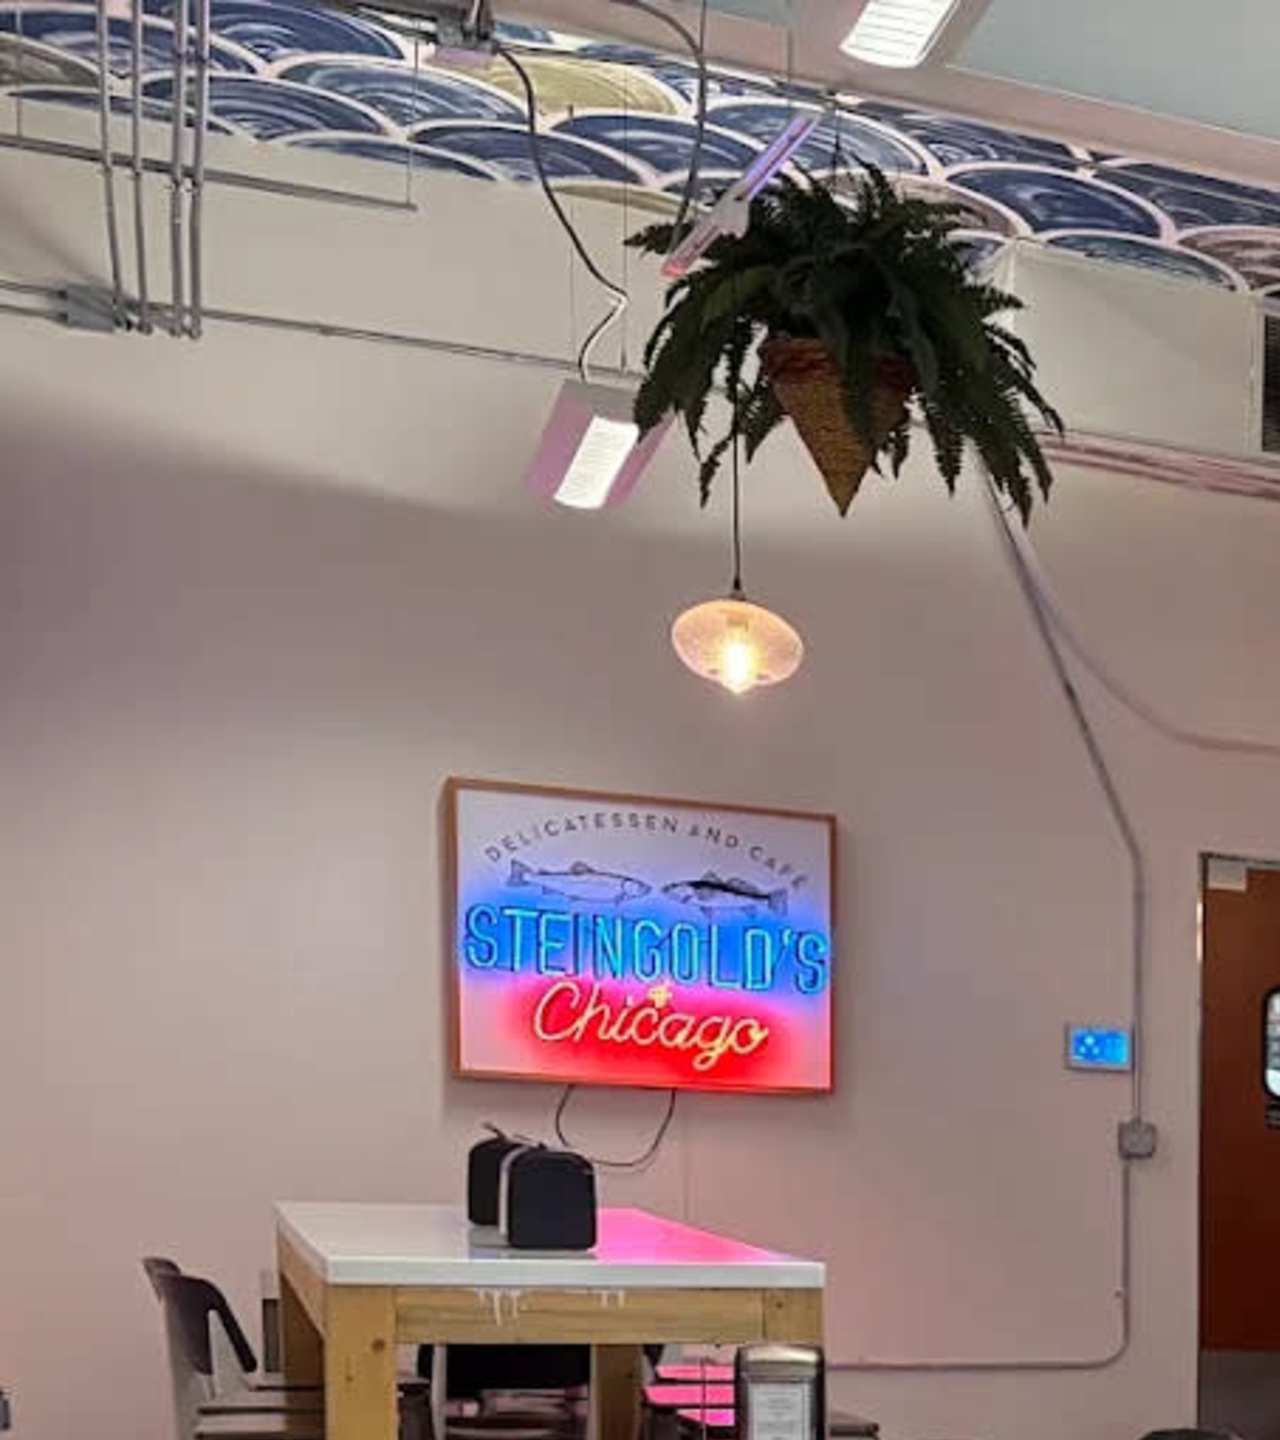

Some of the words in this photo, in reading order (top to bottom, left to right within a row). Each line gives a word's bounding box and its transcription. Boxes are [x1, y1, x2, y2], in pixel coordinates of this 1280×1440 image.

[485, 812, 678, 863] DELICATESSEN
[688, 824, 739, 849] AND
[465, 903, 831, 995] STEINGOLD'S
[534, 980, 769, 1071] Chicago
